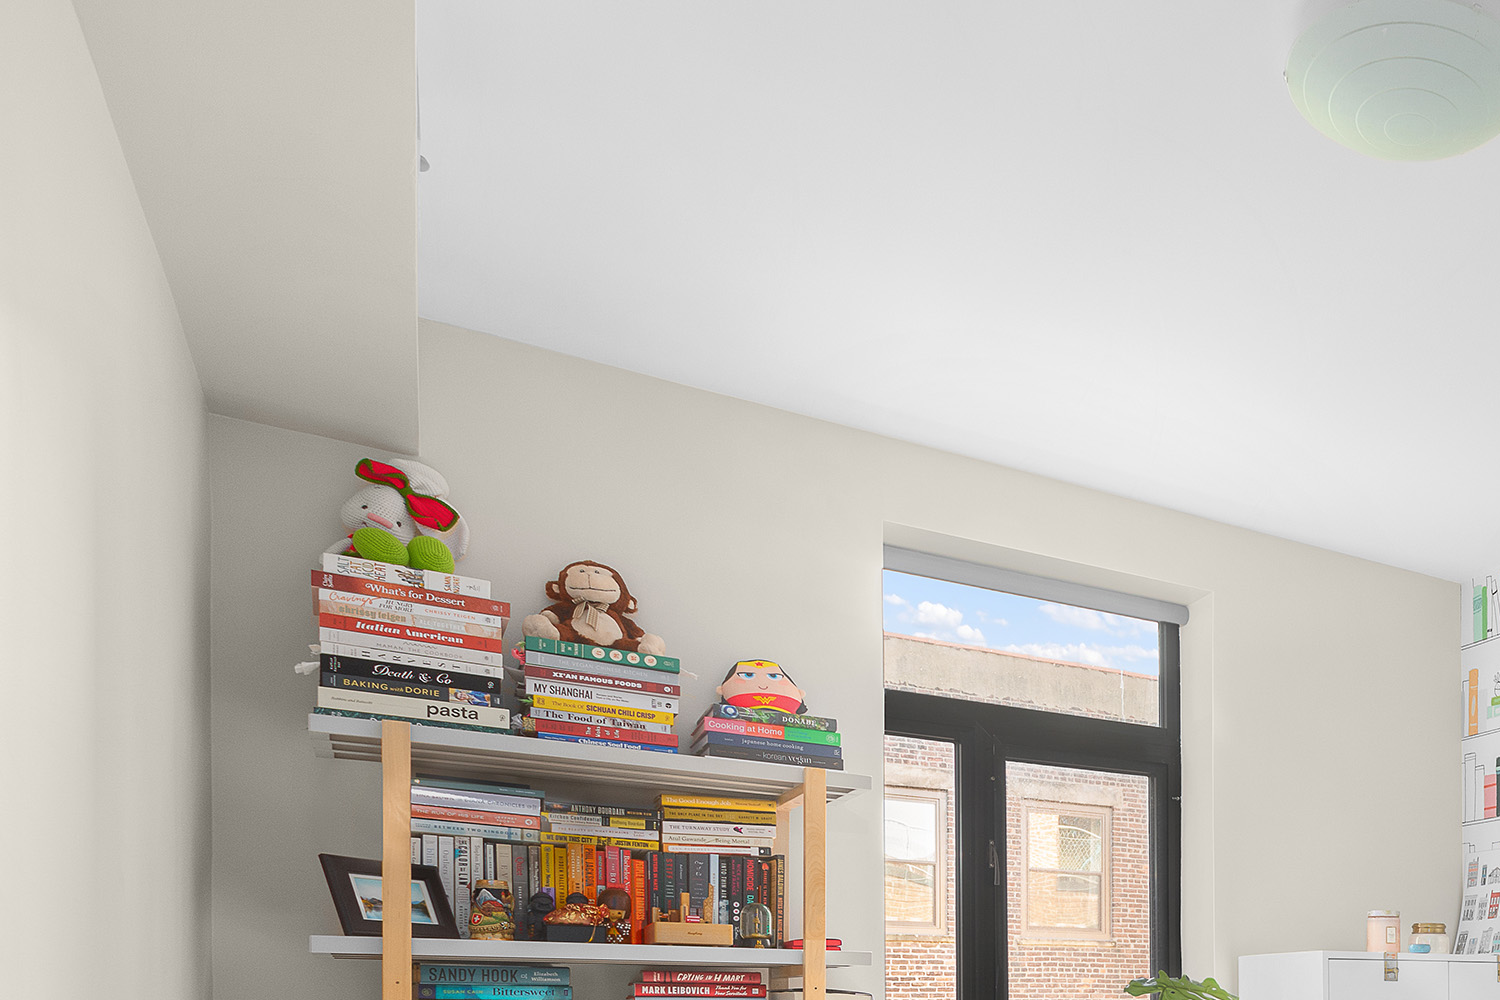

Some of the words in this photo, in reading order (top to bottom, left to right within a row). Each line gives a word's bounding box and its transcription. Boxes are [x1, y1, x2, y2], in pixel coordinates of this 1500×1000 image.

[365, 582, 406, 597] What's
[408, 590, 424, 600] for
[426, 592, 466, 607] Dessert
[424, 608, 451, 616] CHRISSY
[454, 612, 476, 620] TEIGEN
[356, 621, 400, 634] Italian
[405, 628, 464, 644] American
[424, 650, 463, 659] COOKBOOK
[372, 664, 415, 679] Death
[343, 678, 388, 690] BAKING
[405, 686, 440, 697] DORIE
[580, 675, 614, 685] FAMOUS
[614, 680, 642, 688] FOODS
[534, 682, 548, 694] MY
[550, 685, 593, 700] SHANGHAI
[426, 704, 478, 720] pasta
[586, 704, 616, 714] SICHUAN
[618, 708, 636, 716] CHILI
[636, 712, 656, 720] CRISP
[544, 710, 564, 720] The
[567, 713, 593, 723] Food
[610, 718, 646, 730] Taiwan
[708, 720, 745, 732] Cooking
[758, 726, 783, 736] Home
[570, 804, 596, 814] ANTHONY
[598, 806, 626, 816] BOURDAIN
[581, 836, 594, 844] CITY
[666, 858, 674, 879] STIFF
[746, 860, 754, 892] HOMICIDE
[429, 968, 476, 982] SANDY
[482, 970, 518, 982] HOOK
[677, 973, 704, 982] CRYING
[722, 974, 746, 982] MART
[492, 986, 556, 997] Bittersweet
[642, 986, 666, 994] MARK
[668, 986, 710, 995] LEIBOVICH
